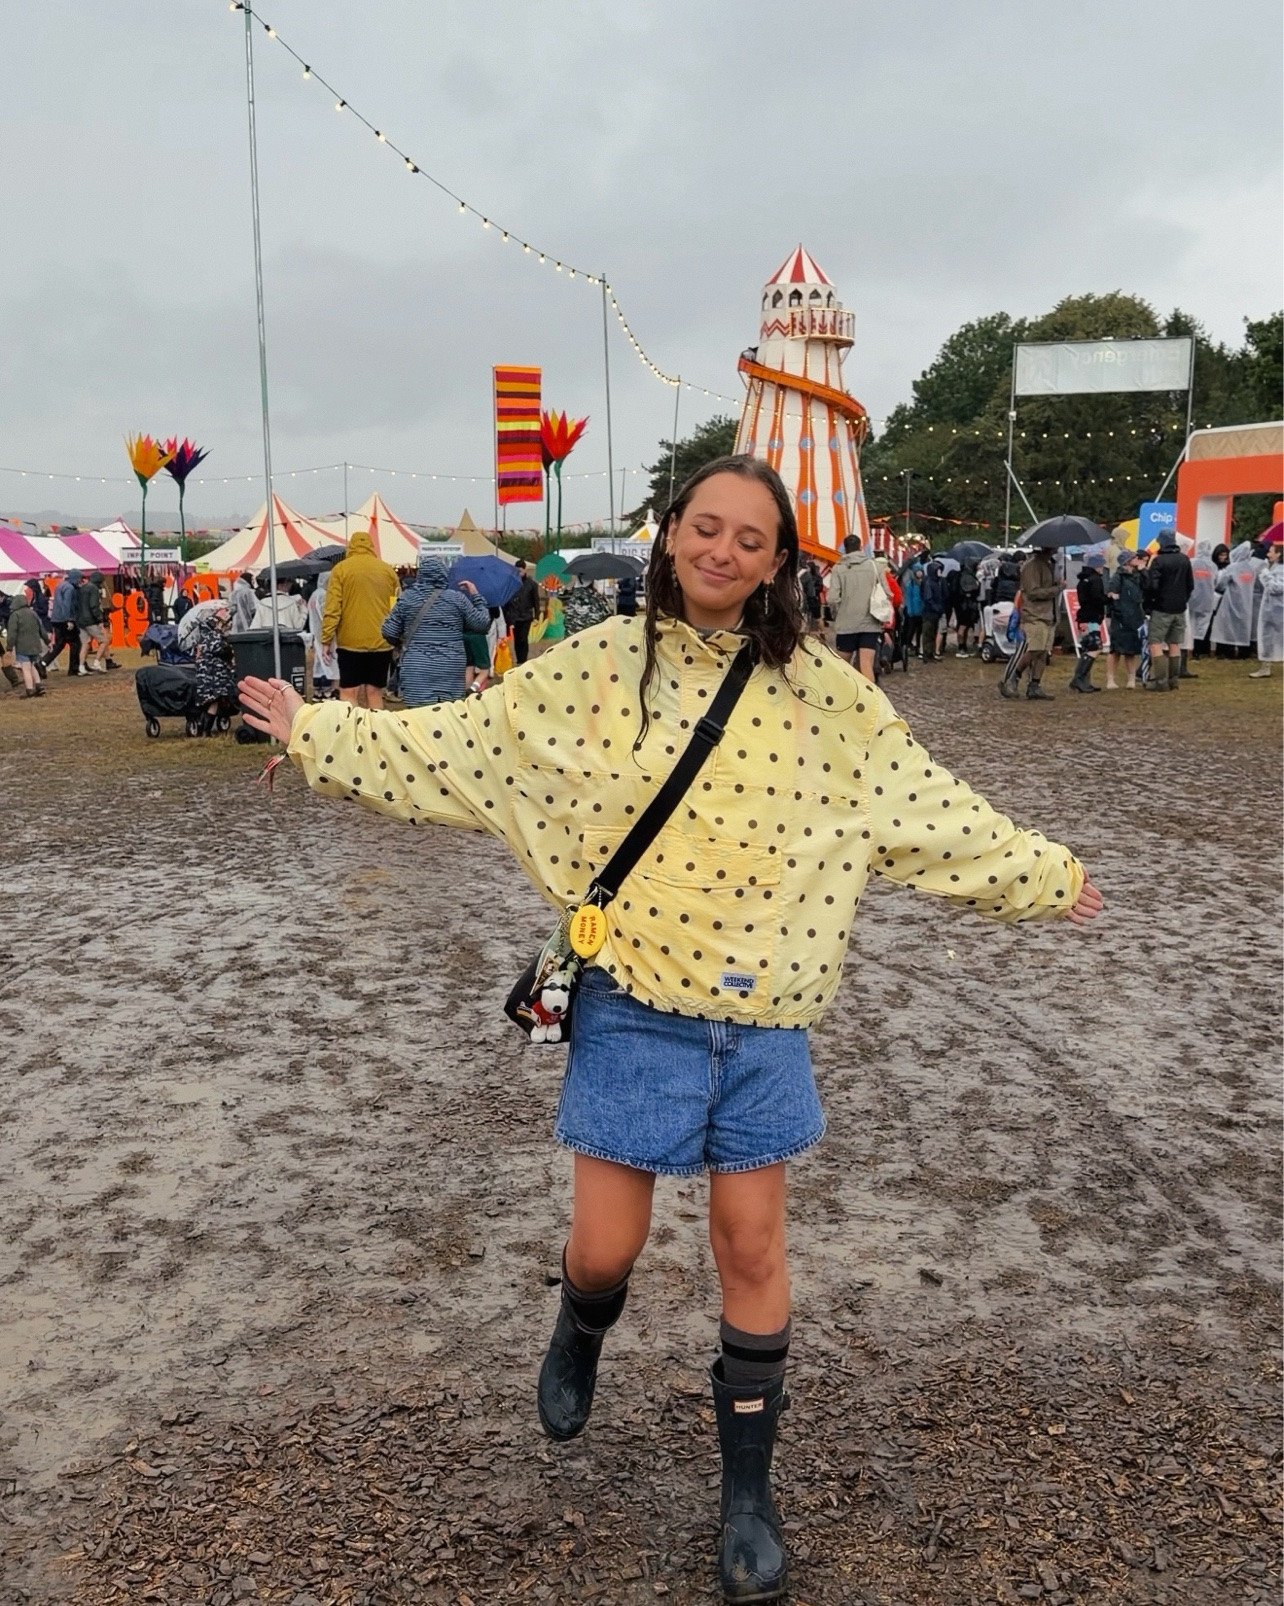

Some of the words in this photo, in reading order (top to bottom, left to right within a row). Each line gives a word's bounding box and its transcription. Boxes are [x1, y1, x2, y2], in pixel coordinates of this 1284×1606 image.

[1150, 512, 1173, 524] Chip
[578, 915, 587, 945] MONEY
[586, 915, 597, 946] RAMEN
